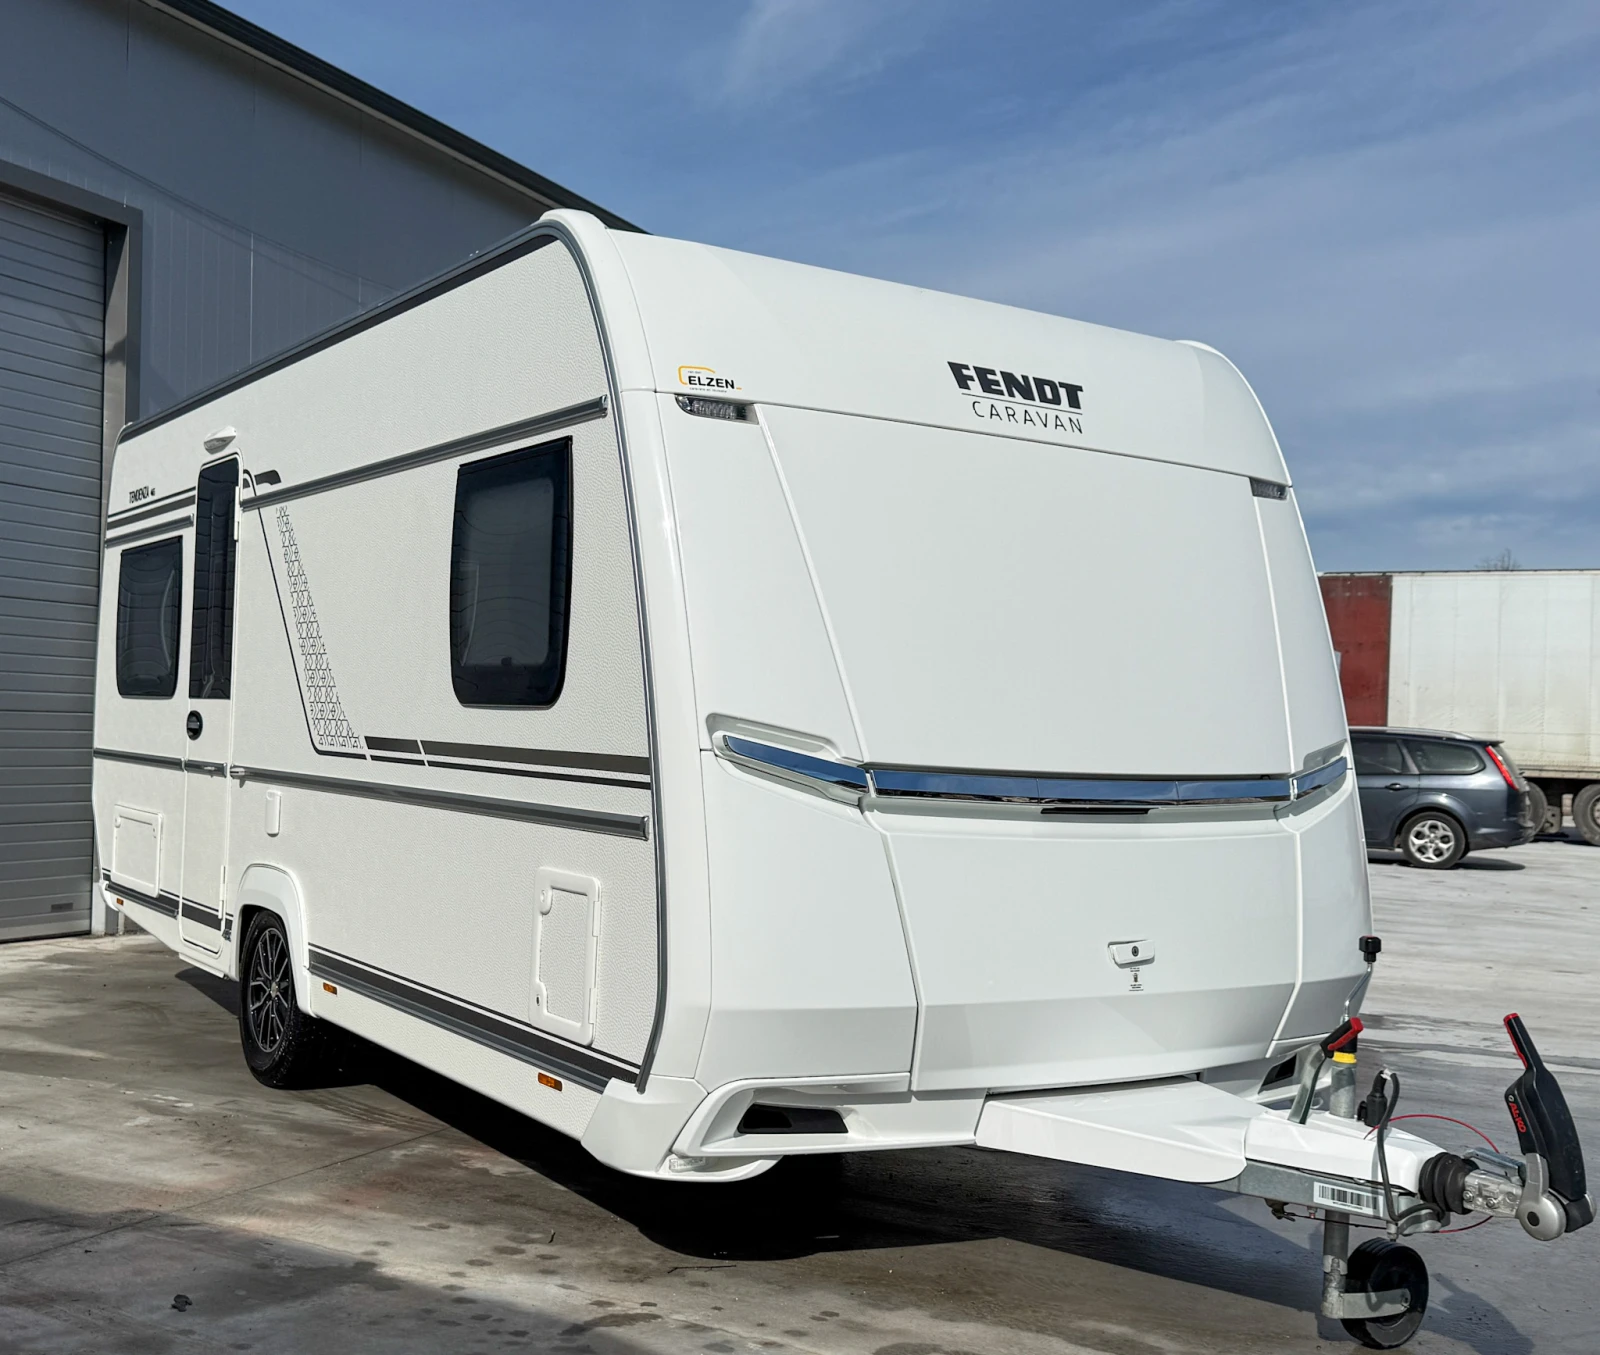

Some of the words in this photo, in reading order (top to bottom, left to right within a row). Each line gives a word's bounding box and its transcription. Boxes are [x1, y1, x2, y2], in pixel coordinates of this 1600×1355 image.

[688, 375, 735, 389] ELZEN
[947, 361, 1083, 410] FENDT
[972, 401, 1083, 434] CARAVAN
